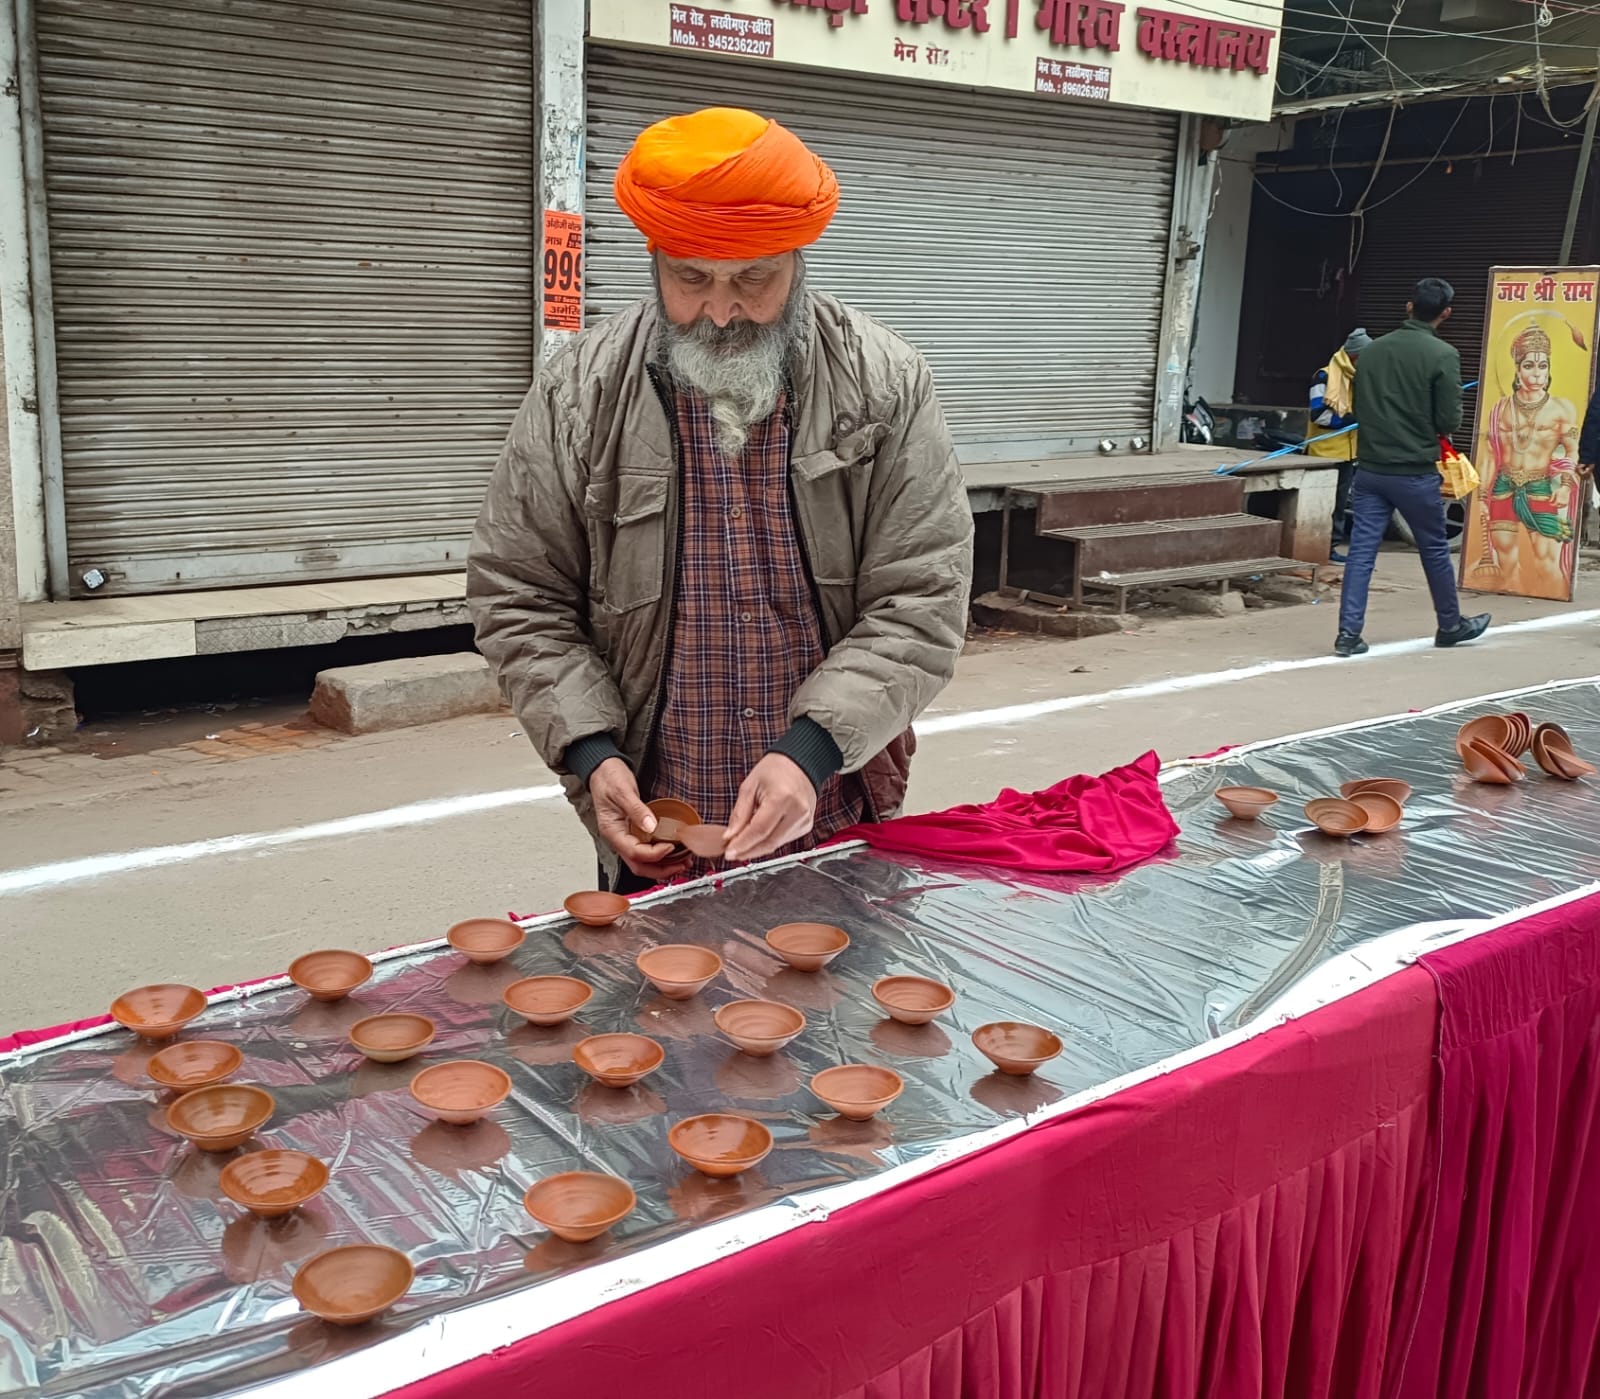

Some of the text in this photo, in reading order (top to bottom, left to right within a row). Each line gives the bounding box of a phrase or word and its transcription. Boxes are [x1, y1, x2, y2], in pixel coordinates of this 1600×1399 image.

[672, 6, 687, 23] मेन
[673, 29, 698, 46] Mob.
[708, 34, 771, 55] 9452362207
[894, 37, 918, 63] मेन
[1137, 7, 1276, 74] वस्त्रालय
[1062, 81, 1109, 100] 8960263607
[545, 236, 562, 246] मात्र
[1497, 277, 1594, 301] जय श्री राम
